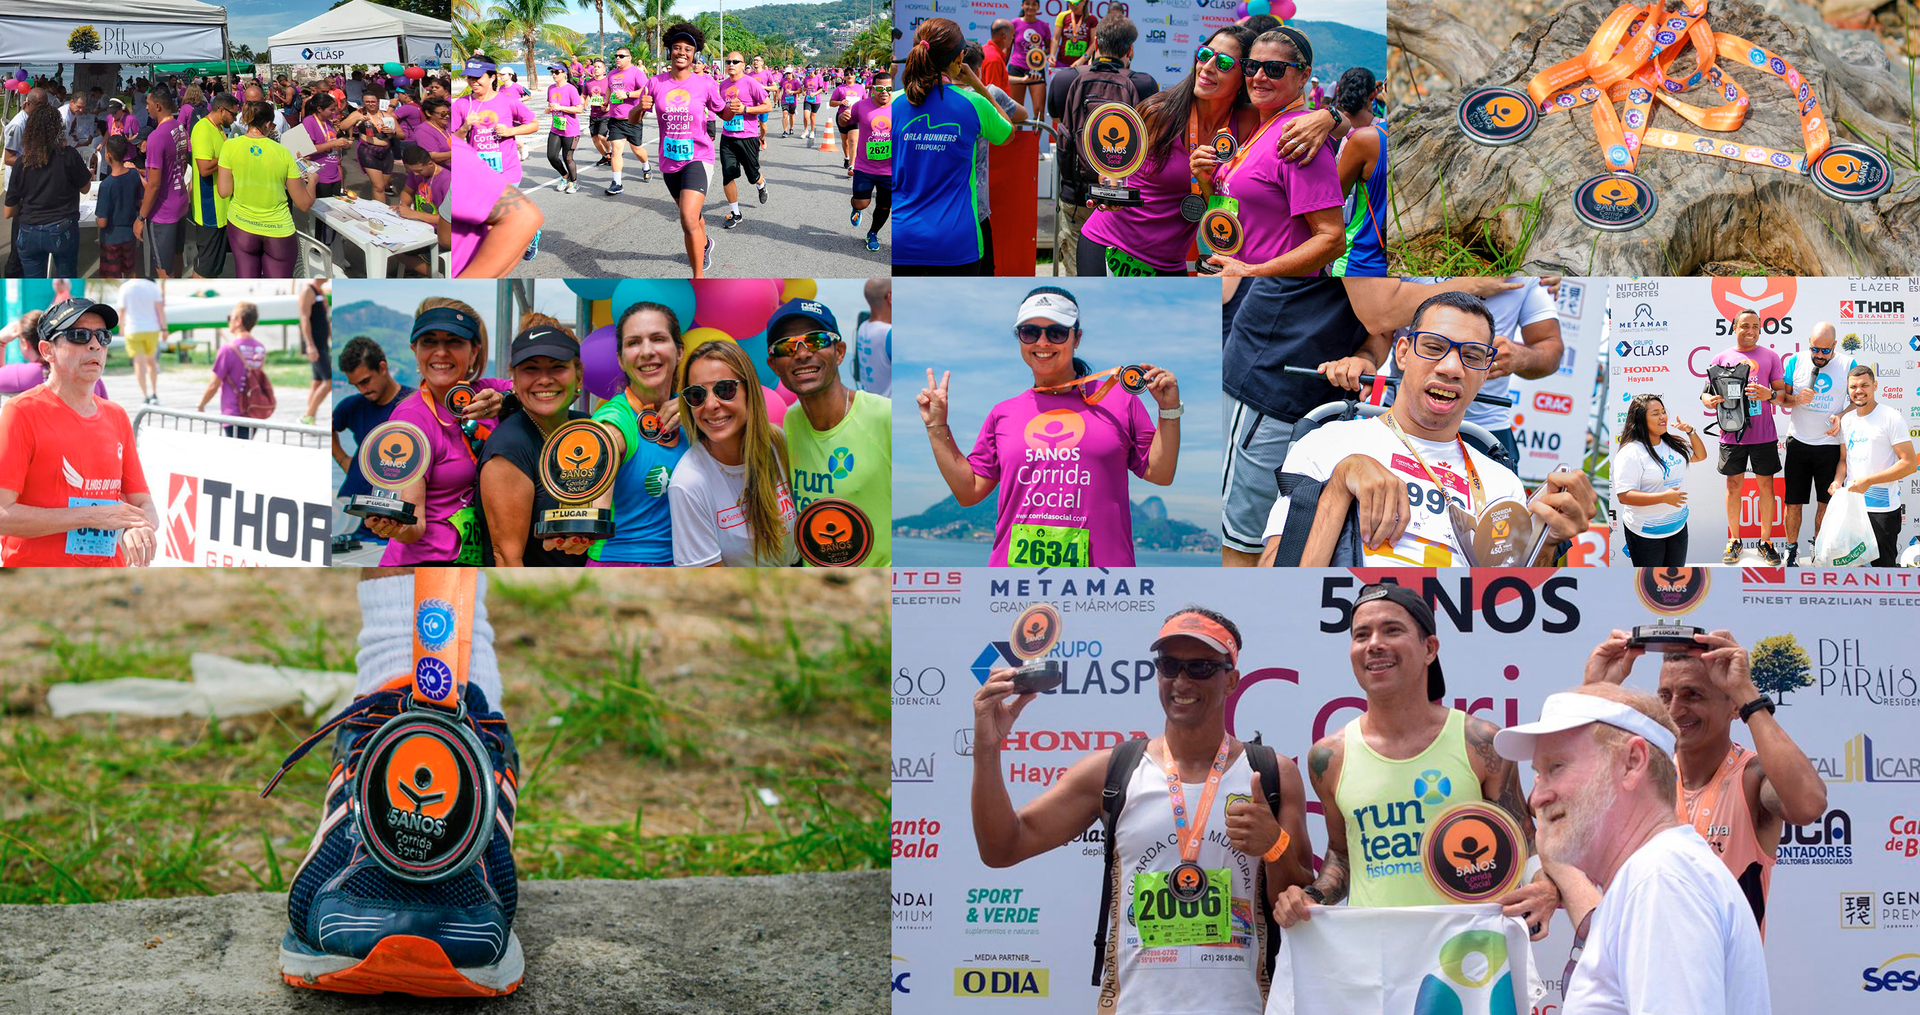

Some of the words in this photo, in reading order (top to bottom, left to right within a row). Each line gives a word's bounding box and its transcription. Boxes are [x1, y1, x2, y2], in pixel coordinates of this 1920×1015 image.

[1210, 0, 1236, 10] CLASP
[104, 27, 126, 41] DEL
[1146, 30, 1166, 39] JCA
[104, 40, 164, 59] PARAÍSO
[314, 50, 344, 60] CLASP
[662, 113, 694, 122] Corrida
[666, 122, 690, 130] Social
[904, 132, 922, 140] ORLA
[922, 134, 958, 142] RUNNERS
[666, 142, 689, 154] 3415
[869, 145, 890, 154] 2627
[914, 144, 946, 152] ITAIPUAÇU
[1616, 280, 1659, 292] NITERÓI
[1850, 283, 1856, 292] E
[1862, 283, 1899, 292] LAZER
[1854, 300, 1904, 313] THOR
[1634, 345, 1668, 356] CLASP
[1624, 366, 1670, 374] HONDA
[1535, 398, 1570, 412] CRAC
[1516, 430, 1561, 450] ANO
[1026, 447, 1080, 462] 5ANOS
[561, 468, 594, 479] 5ANOS
[1018, 464, 1091, 486] Corrida
[794, 469, 834, 494] run
[1022, 488, 1082, 508] Social
[1016, 512, 1087, 522] www.corridasocial.com
[1490, 508, 1512, 518] CORRIDA
[1492, 514, 1510, 522] SOCIAL
[1014, 538, 1080, 567] 2634
[892, 572, 962, 585] ITOS
[1800, 572, 1920, 586] GRANIT
[990, 579, 1155, 596] METAMAR
[892, 596, 961, 604] ELECTION
[1062, 601, 1071, 612] E
[1075, 598, 1156, 612] MÁRMORES
[1320, 576, 1581, 634] 5NOS
[1742, 596, 1793, 605] FINEST
[1800, 596, 1872, 606] BRAZILIAN
[1044, 640, 1103, 658] RUPO
[1819, 638, 1866, 668] DEL
[1000, 730, 1150, 751] HONDA
[387, 808, 446, 836] 5ANOS
[1354, 800, 1425, 832] run
[396, 830, 432, 850] Corrida
[1886, 837, 1904, 852] de
[397, 843, 427, 860] Social
[1776, 846, 1852, 858] ONTADORES
[1208, 830, 1251, 894] MUNICIPAL
[1456, 858, 1497, 877] 5ANOS
[1366, 861, 1422, 880] fisioma
[1464, 872, 1492, 884] Corrida
[1469, 880, 1491, 890] Social
[966, 888, 1023, 904] SPORT
[966, 907, 979, 923] &
[984, 907, 1040, 923] VERDE
[965, 928, 1006, 936] suplementos
[1013, 926, 1040, 935] naturais
[1200, 954, 1214, 962] (21)
[962, 970, 986, 994] O
[991, 971, 1040, 994] DIA
[1862, 967, 1920, 992] Ses
